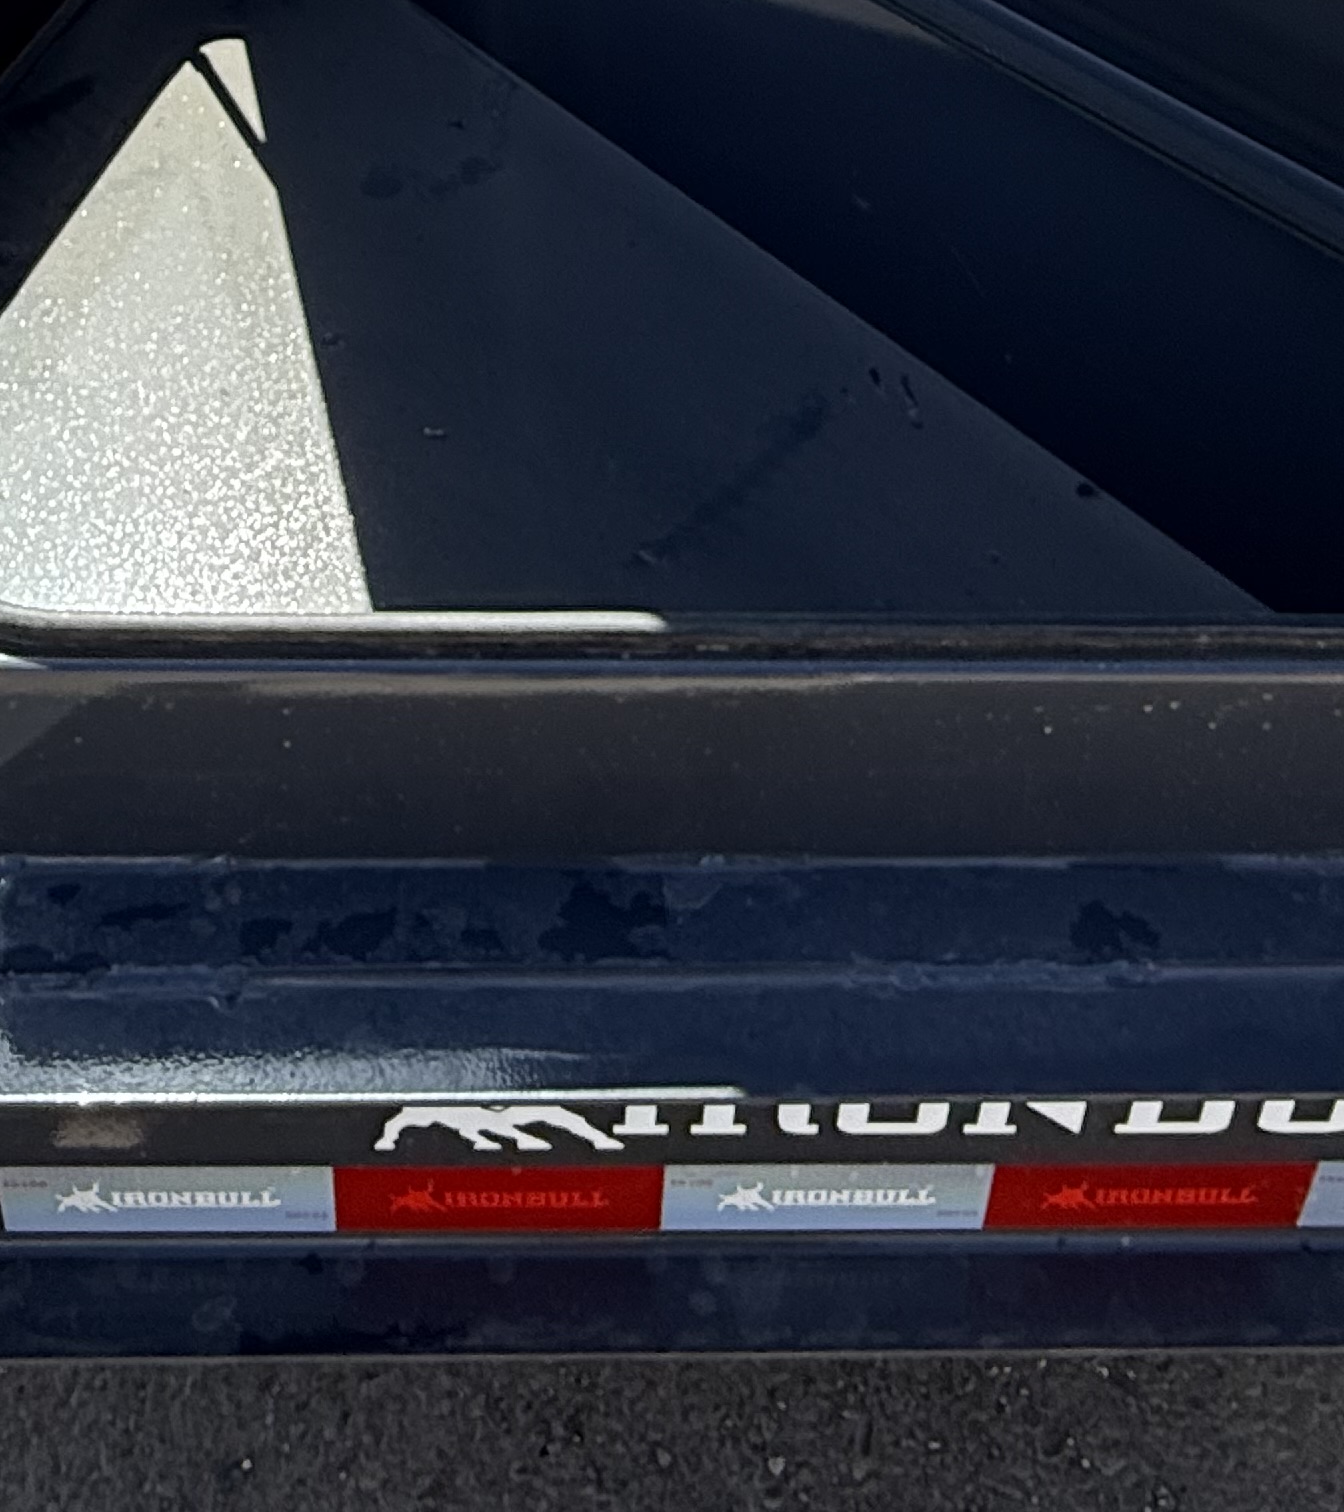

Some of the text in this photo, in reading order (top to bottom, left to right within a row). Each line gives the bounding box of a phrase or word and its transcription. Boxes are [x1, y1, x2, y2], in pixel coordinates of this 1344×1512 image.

[112, 1188, 282, 1208] IRONBULL
[444, 1190, 610, 1208] IRONBULL
[772, 1187, 937, 1207] IRONBULL
[1095, 1185, 1258, 1205] IRONBULL
